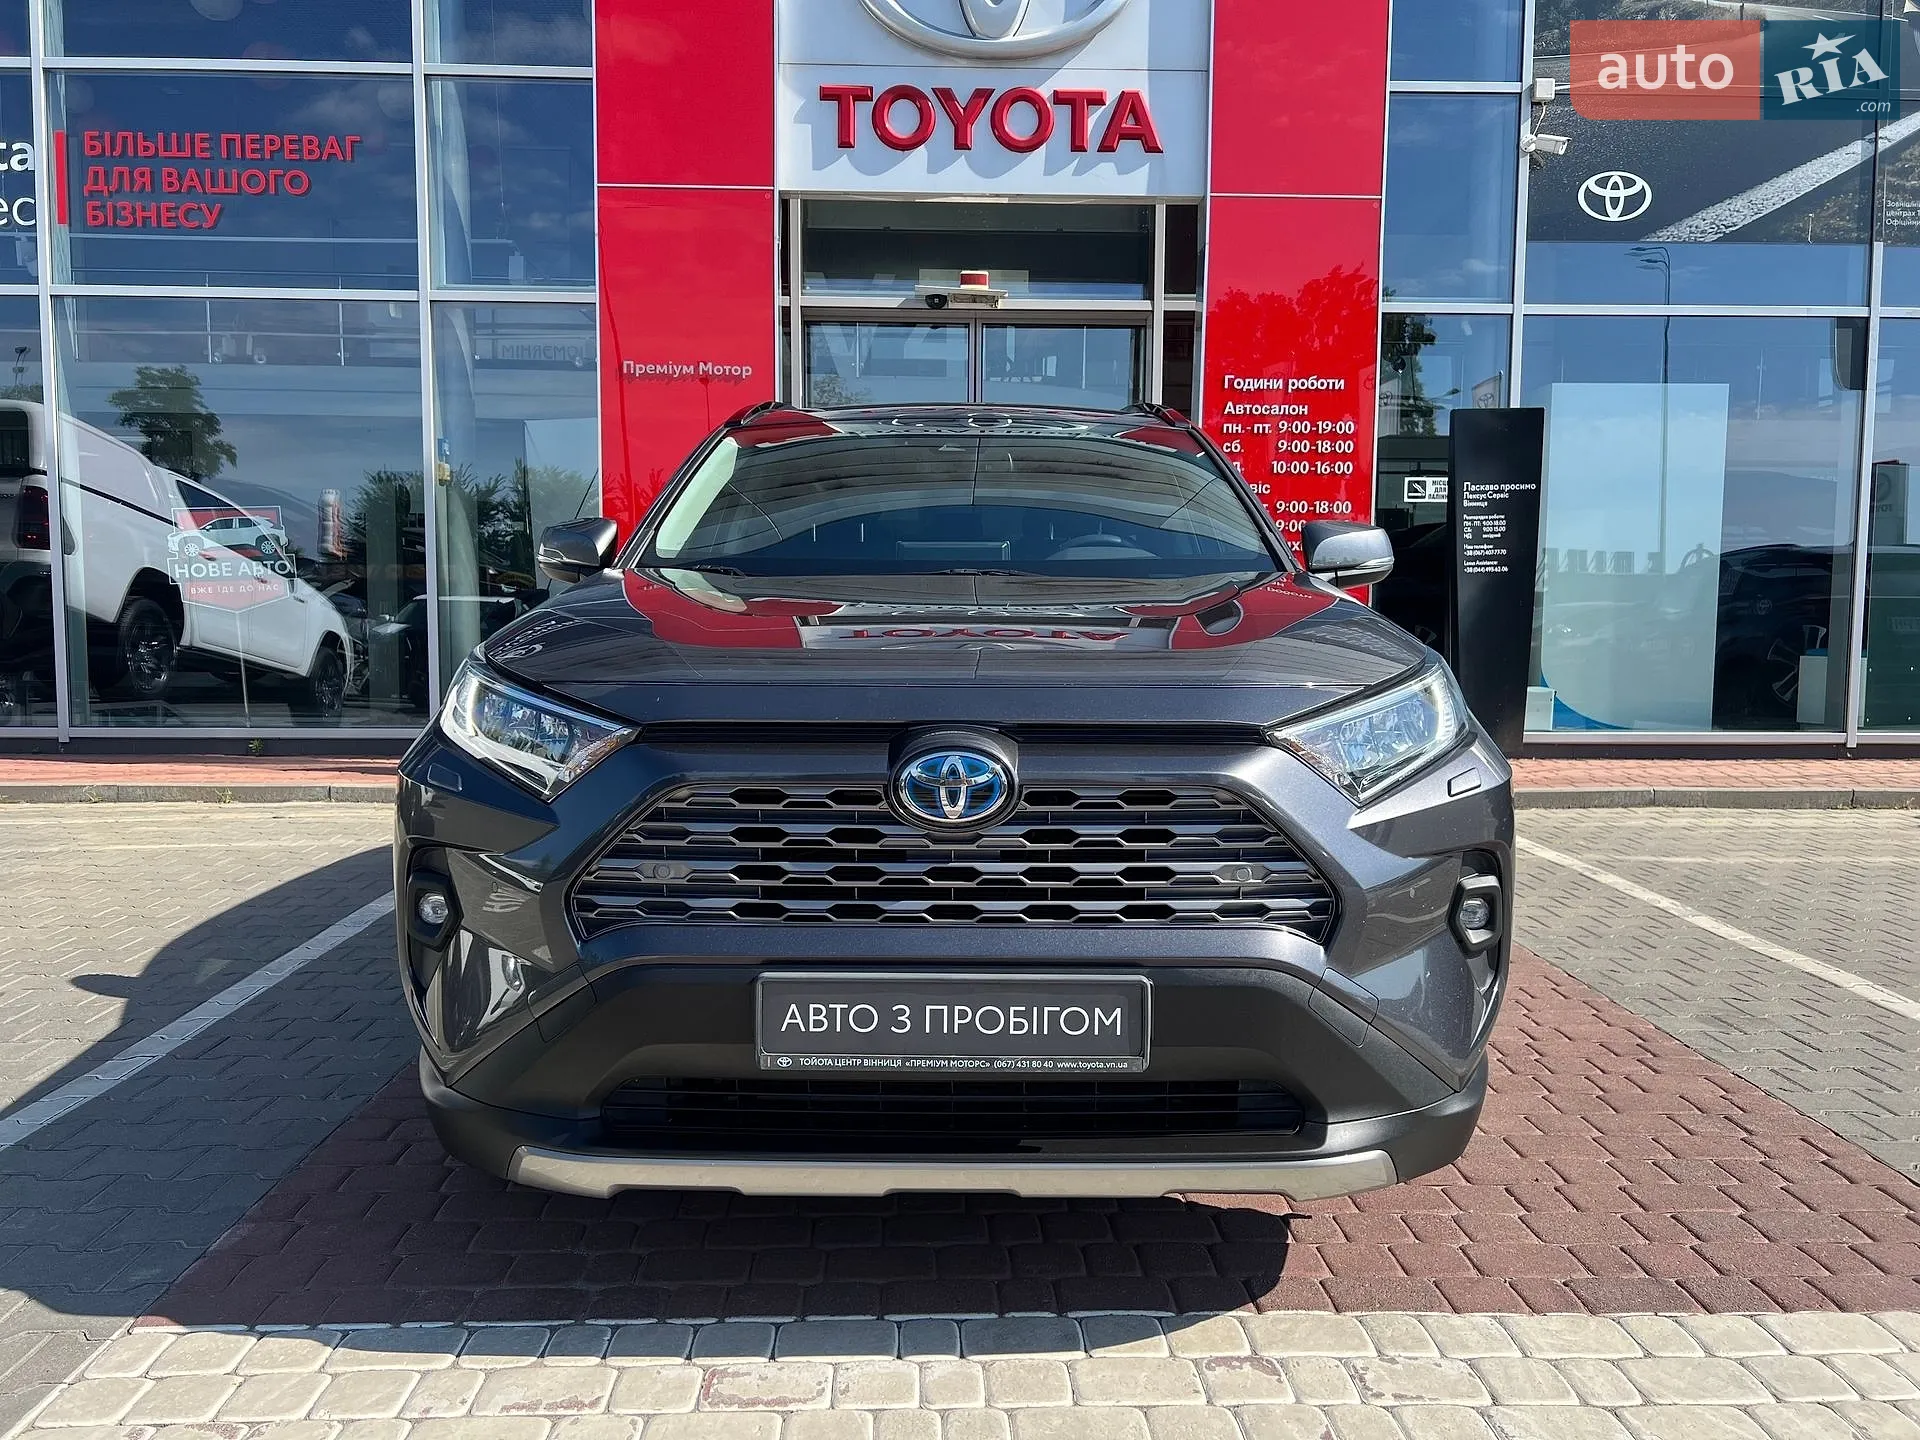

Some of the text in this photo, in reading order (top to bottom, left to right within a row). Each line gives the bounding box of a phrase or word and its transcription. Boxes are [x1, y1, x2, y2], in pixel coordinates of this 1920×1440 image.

[819, 84, 1164, 154] TOYOTA
[84, 131, 361, 161] БІЛЬШЕ ПЕРЕВАГ
[84, 166, 310, 197] ДЛЯ ВАШОГО
[86, 201, 222, 229] БІЗНЕСУ
[623, 360, 752, 379] Преміум Мотор
[1224, 375, 1345, 393] Години роботи
[1224, 401, 1309, 415] Автосалон
[1278, 420, 1355, 434] 9:00-19:00
[1222, 439, 1354, 454] сб. 9:00-18:00
[1271, 461, 1353, 475] 10:00-16:00
[1463, 482, 1537, 493] Ласкаво просимо
[1276, 501, 1352, 514] 9:00-18:00
[174, 560, 291, 579] НОВЕ АВТО
[780, 1003, 1122, 1036] АВТО З ПРОБІГОМ
[800, 1057, 1128, 1071] ТОЙОТА ЦЕНТР ВІННИЦЯ «ПРЕМІУМ МОТОРС» (067) 431 80 40 www.toyota.vn.ua
